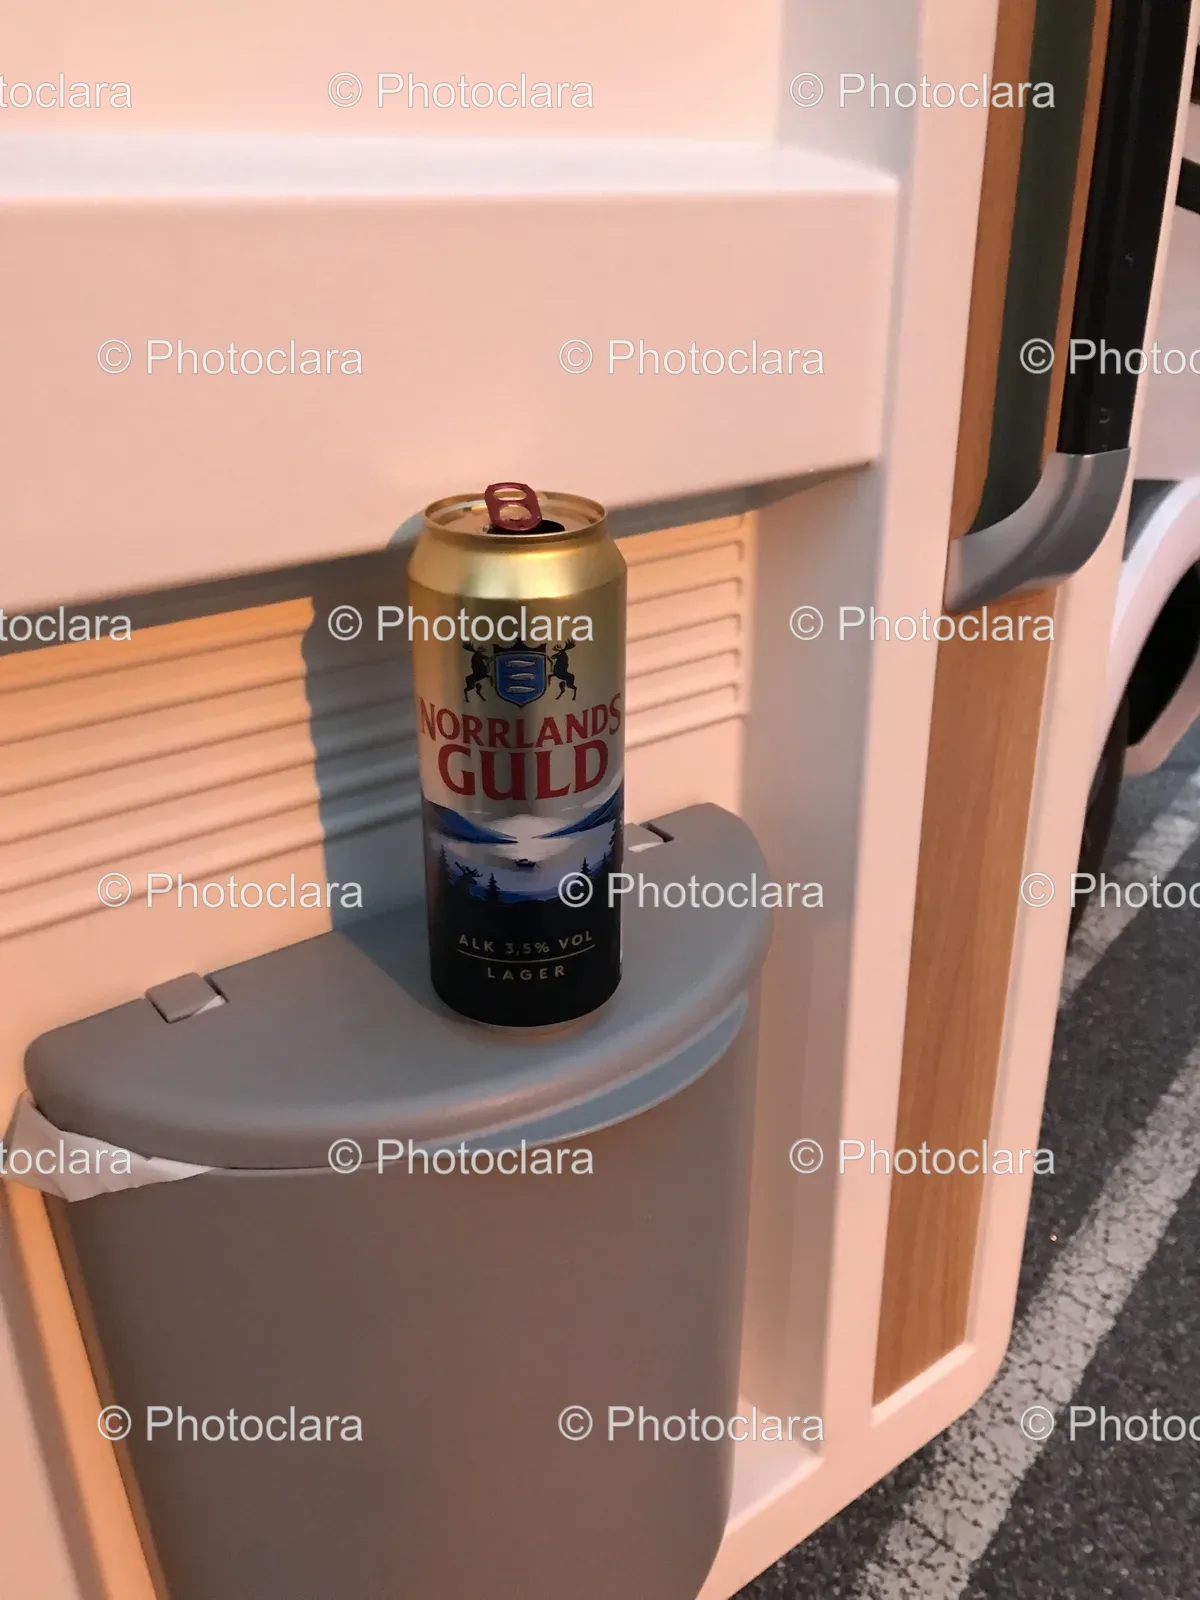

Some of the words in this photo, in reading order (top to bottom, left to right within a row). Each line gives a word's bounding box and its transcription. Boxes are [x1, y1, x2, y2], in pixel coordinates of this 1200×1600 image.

[419, 693, 621, 749] NORRLANDS
[437, 739, 609, 801] GULD
[459, 934, 494, 952] ALK
[505, 941, 550, 956] 3,5%
[558, 930, 593, 950] VOL
[487, 965, 565, 981] LAGER
